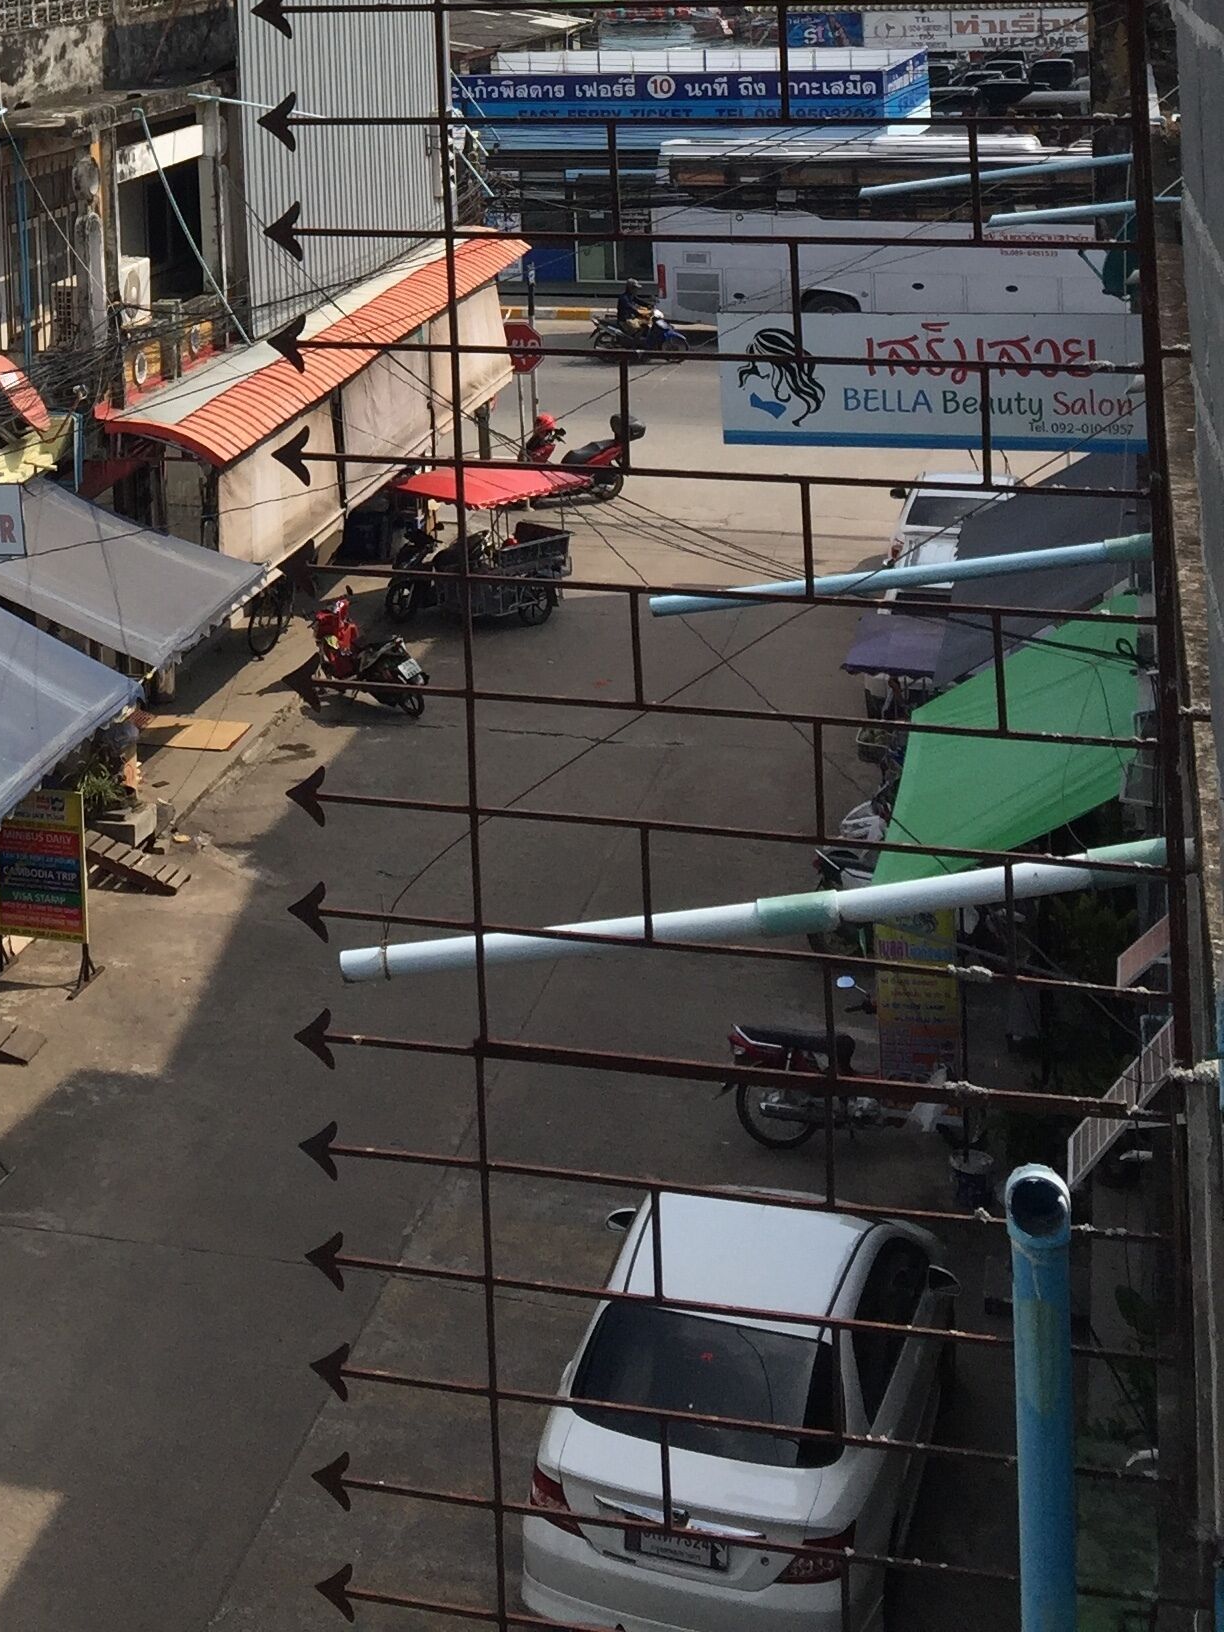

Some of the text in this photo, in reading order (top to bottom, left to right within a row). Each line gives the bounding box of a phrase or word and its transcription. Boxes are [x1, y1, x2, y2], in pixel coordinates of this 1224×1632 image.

[650, 79, 672, 95] 10
[684, 77, 728, 97] นาที
[843, 388, 933, 413] BELLA
[1052, 389, 1134, 416] Salon
[1029, 421, 1049, 433] Tel.
[3, 865, 77, 881] CAMBODIA TRIP
